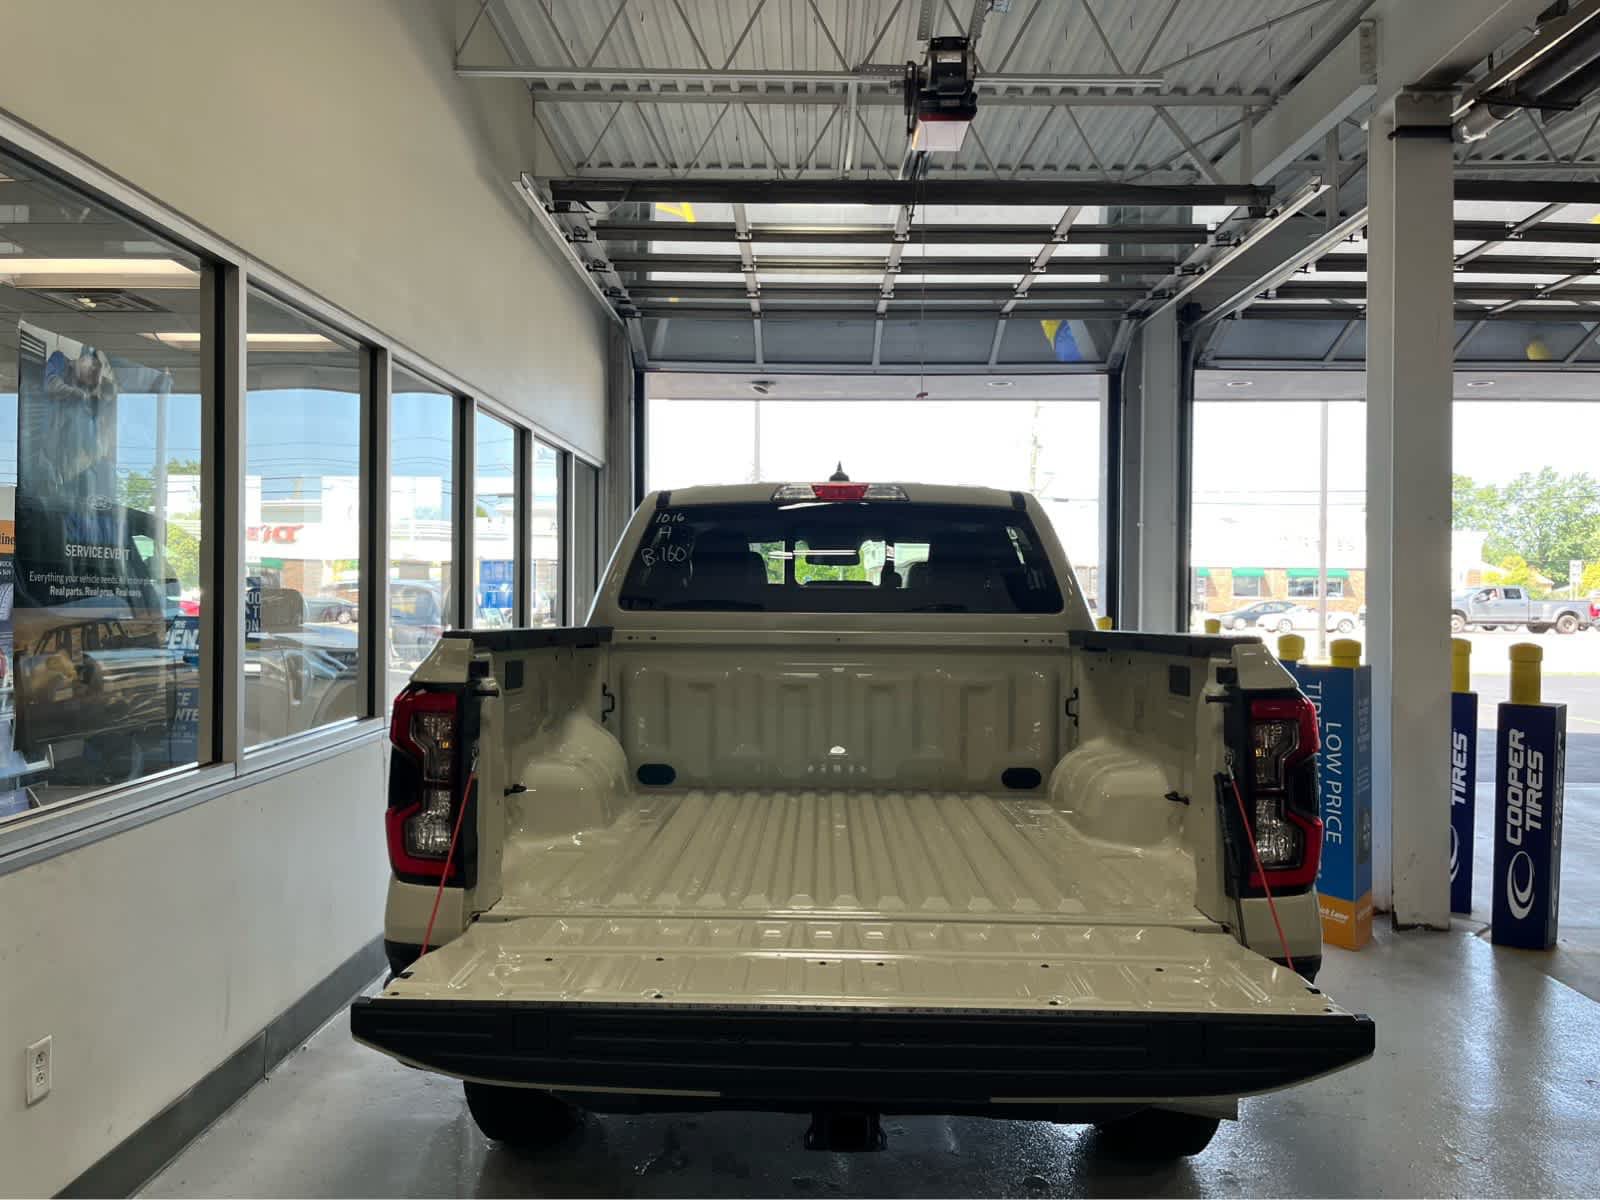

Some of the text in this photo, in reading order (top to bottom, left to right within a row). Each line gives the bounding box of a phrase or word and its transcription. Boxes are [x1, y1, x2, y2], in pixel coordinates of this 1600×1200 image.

[29, 571, 65, 585] Everything
[65, 575, 79, 585] your
[80, 574, 100, 584] vehicle
[65, 544, 103, 559] SERVICE
[50, 586, 65, 596] Real
[65, 587, 83, 598] parts.
[1325, 722, 1342, 845] LOW PRICE
[1451, 731, 1468, 806] TIRES
[1506, 728, 1525, 846] COOPER
[1525, 749, 1544, 831] TIRES
